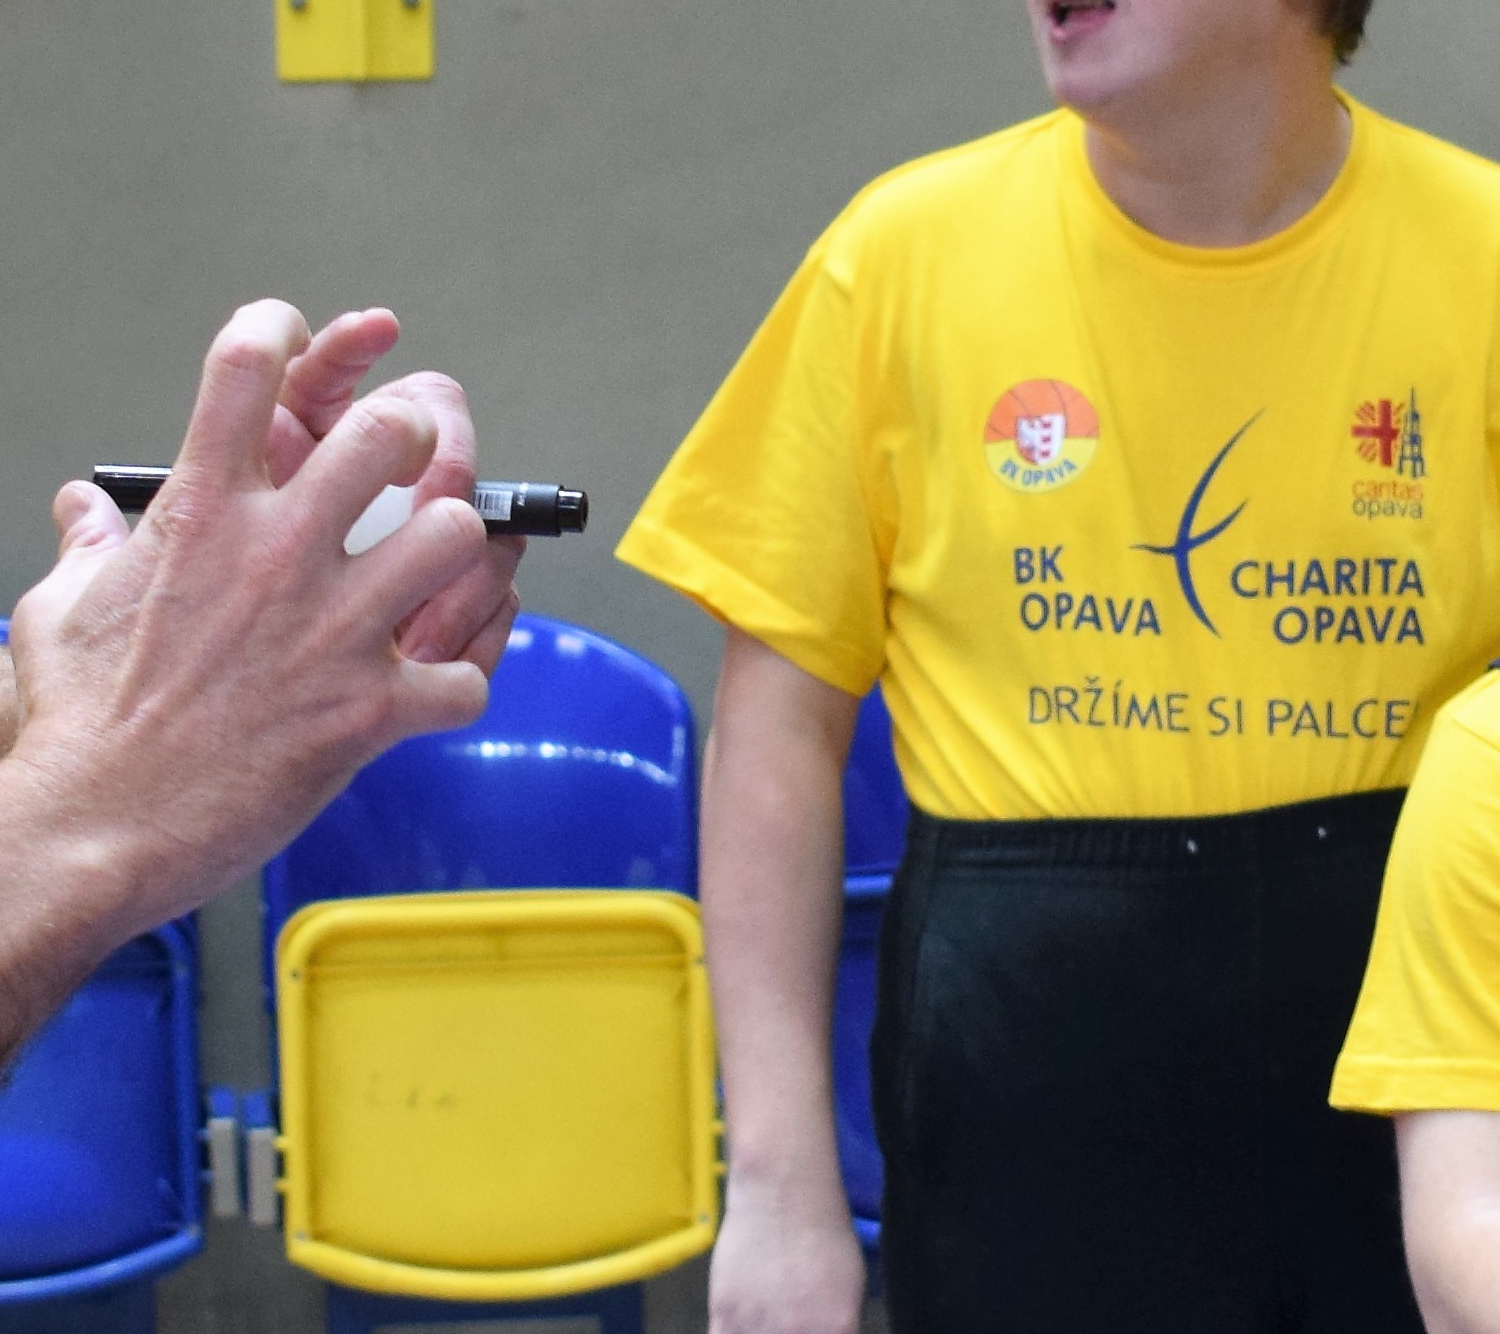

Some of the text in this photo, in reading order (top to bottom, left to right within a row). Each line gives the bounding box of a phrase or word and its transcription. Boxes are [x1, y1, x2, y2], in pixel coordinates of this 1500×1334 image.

[1022, 459, 1077, 485] OPAVA
[1352, 499, 1423, 521] opava
[1014, 546, 1063, 585] BK
[1231, 558, 1425, 599] CHARITA
[1019, 592, 1161, 636] OPAVA
[1272, 607, 1425, 645] OPAVA
[1028, 676, 1189, 733] DRŽÍME
[1208, 696, 1244, 738] SI
